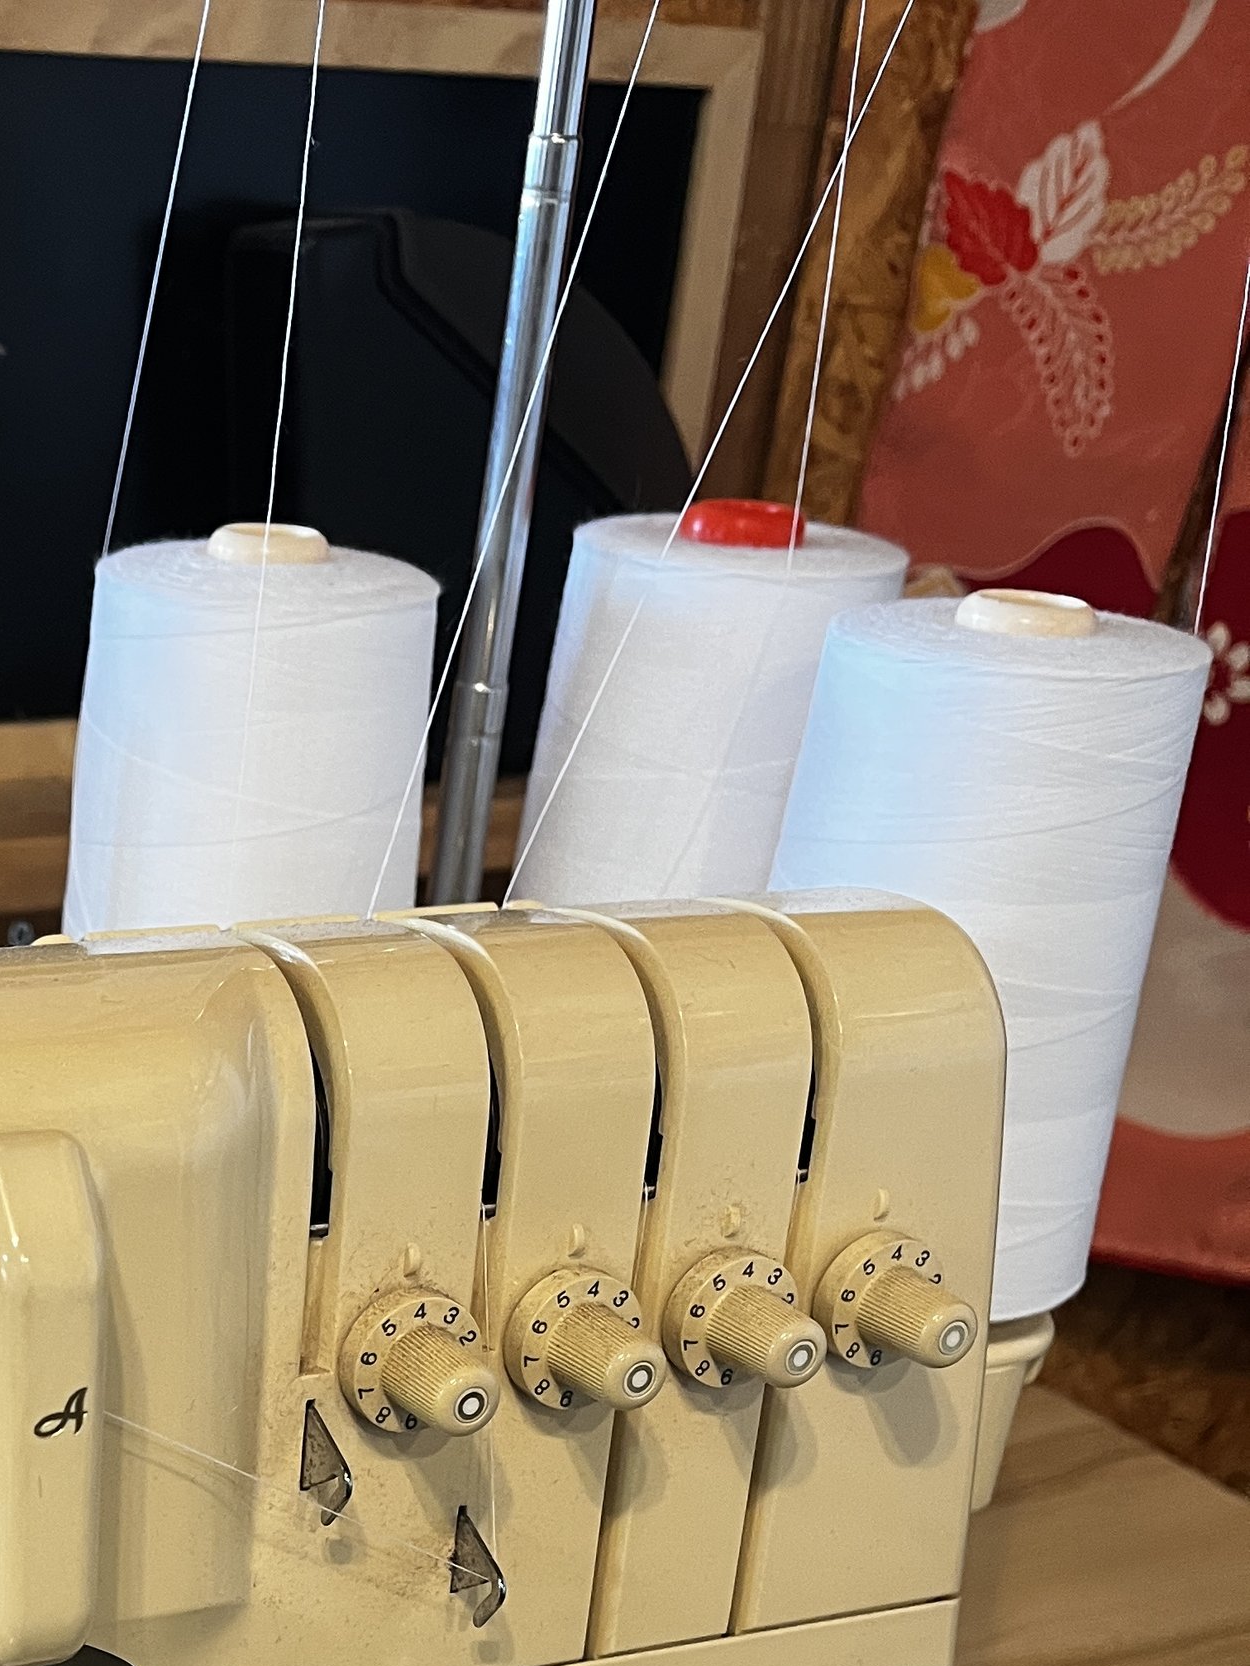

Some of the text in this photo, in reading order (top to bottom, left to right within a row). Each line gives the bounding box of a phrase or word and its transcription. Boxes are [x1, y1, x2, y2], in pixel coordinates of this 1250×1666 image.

[891, 1245, 903, 1261] 4
[916, 1250, 930, 1267] 3
[742, 1261, 755, 1278] 4
[863, 1258, 876, 1276] 5
[712, 1273, 726, 1292] 5
[767, 1267, 783, 1286] 3
[587, 1280, 600, 1298] 4
[841, 1288, 856, 1303] 6
[557, 1290, 570, 1308] 5
[612, 1290, 629, 1308] 3
[413, 1302, 427, 1319] 4
[443, 1306, 460, 1325] 3
[689, 1304, 706, 1318] 6
[381, 1318, 397, 1337] 5
[531, 1319, 548, 1334] 6
[834, 1323, 849, 1335] 7
[458, 1329, 477, 1347] 2
[683, 1339, 699, 1352] 7
[360, 1351, 378, 1366] 6
[846, 1342, 861, 1359] 8
[523, 1355, 540, 1368] 7
[695, 1359, 711, 1377] 8
[357, 1388, 375, 1400] 7
[534, 1378, 551, 1396] 8
[375, 1406, 392, 1424] 8
